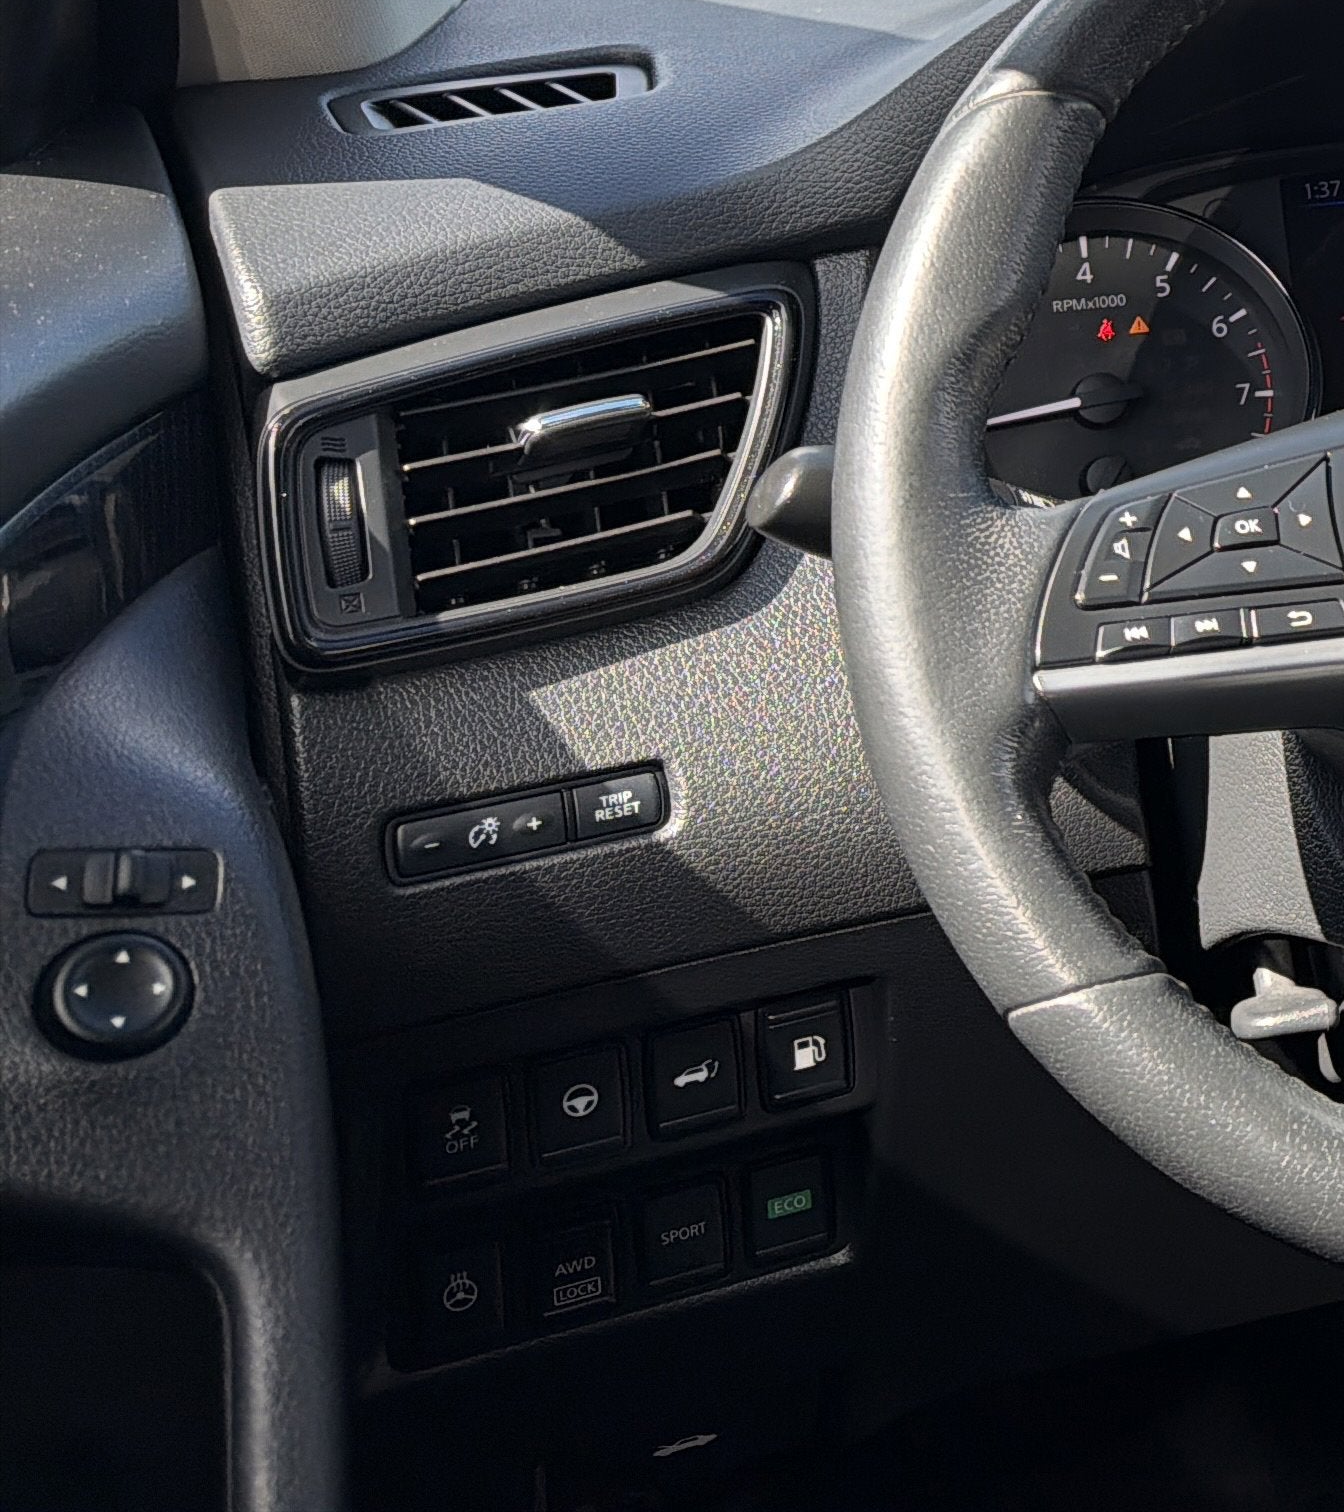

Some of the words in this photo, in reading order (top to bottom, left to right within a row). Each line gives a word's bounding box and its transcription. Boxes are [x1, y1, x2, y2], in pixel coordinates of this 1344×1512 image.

[1304, 179, 1341, 199] 1:37
[1076, 262, 1094, 284] 4
[1155, 275, 1171, 298] 5
[1052, 293, 1127, 313] RPMx1000
[1212, 315, 1228, 338] 6
[1235, 382, 1251, 406] 7
[1234, 519, 1263, 535] OK
[599, 790, 634, 807] TRIP
[594, 800, 641, 822] RESET
[444, 1134, 480, 1155] OFF
[773, 1194, 807, 1216] ECO
[660, 1221, 707, 1246] SPORT
[554, 1255, 597, 1278] AWD
[559, 1281, 597, 1302] LOCK
